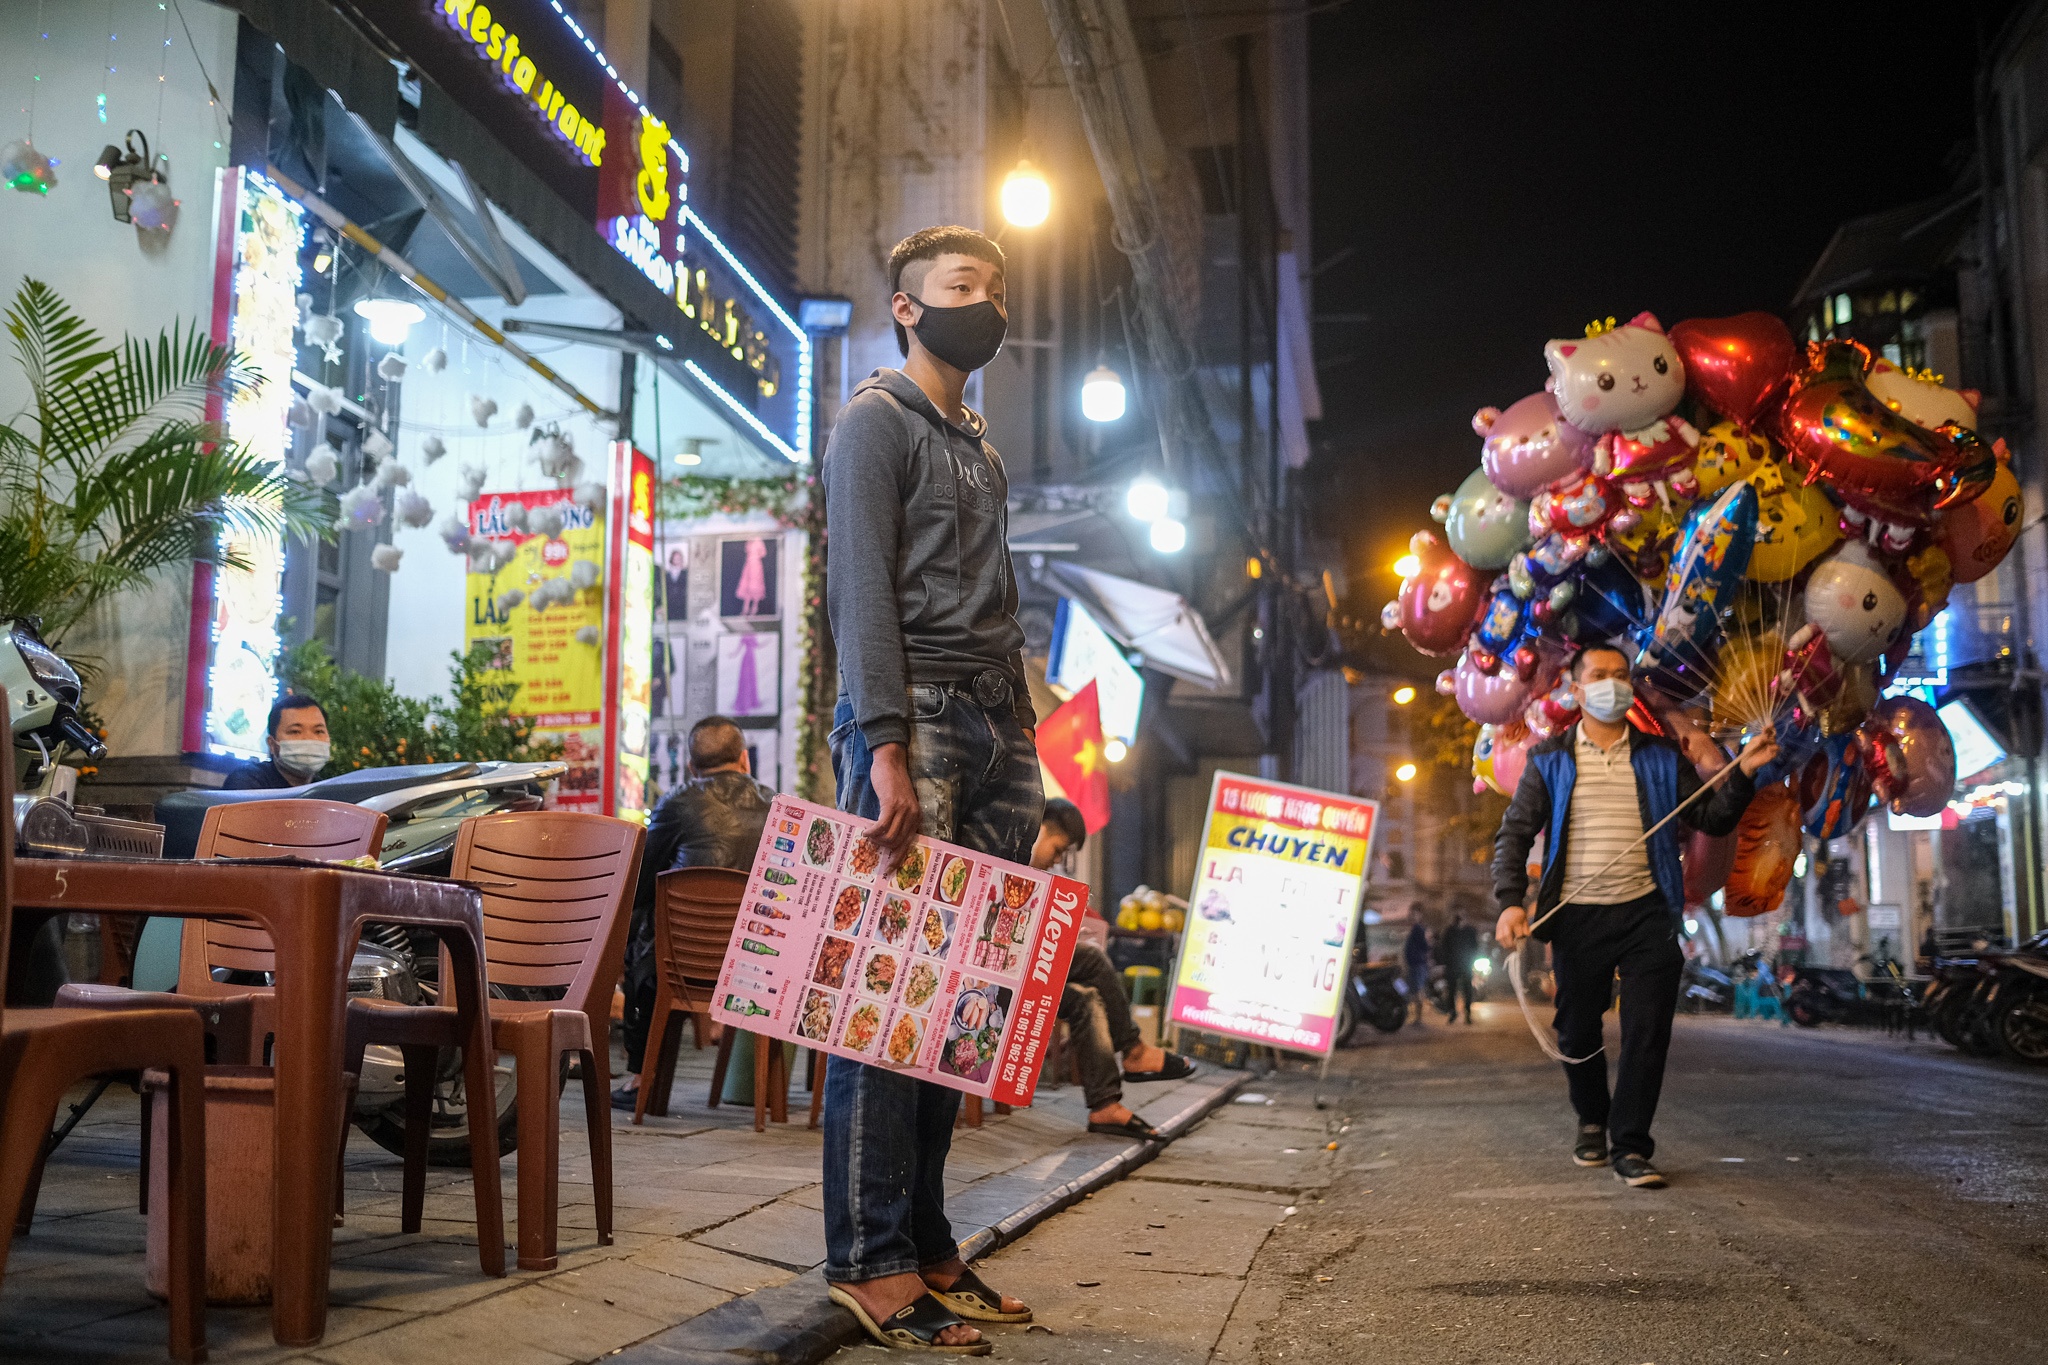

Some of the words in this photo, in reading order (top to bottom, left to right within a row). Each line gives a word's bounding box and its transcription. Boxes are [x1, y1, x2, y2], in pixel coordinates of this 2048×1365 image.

[444, 0, 607, 167] Restaurant
[755, 865, 763, 877] 30K
[51, 869, 69, 898] 5
[750, 882, 758, 894] 35K
[745, 900, 753, 912] 30K
[739, 918, 747, 929] 25K
[734, 936, 742, 948] 35K
[1032, 887, 1078, 984] Menu
[722, 973, 731, 987] 180K
[716, 993, 725, 1007] 120K
[1020, 999, 1035, 1016] Tel:
[1040, 995, 1052, 1007] 15
[773, 1008, 781, 1020] 80K
[1030, 1007, 1049, 1037] Lương
[1013, 1017, 1029, 1042] 0912
[1007, 1042, 1022, 1062] 962
[1023, 1038, 1040, 1064] Ngọc
[1002, 1062, 1016, 1082] 023
[1014, 1065, 1032, 1095] Quyến
